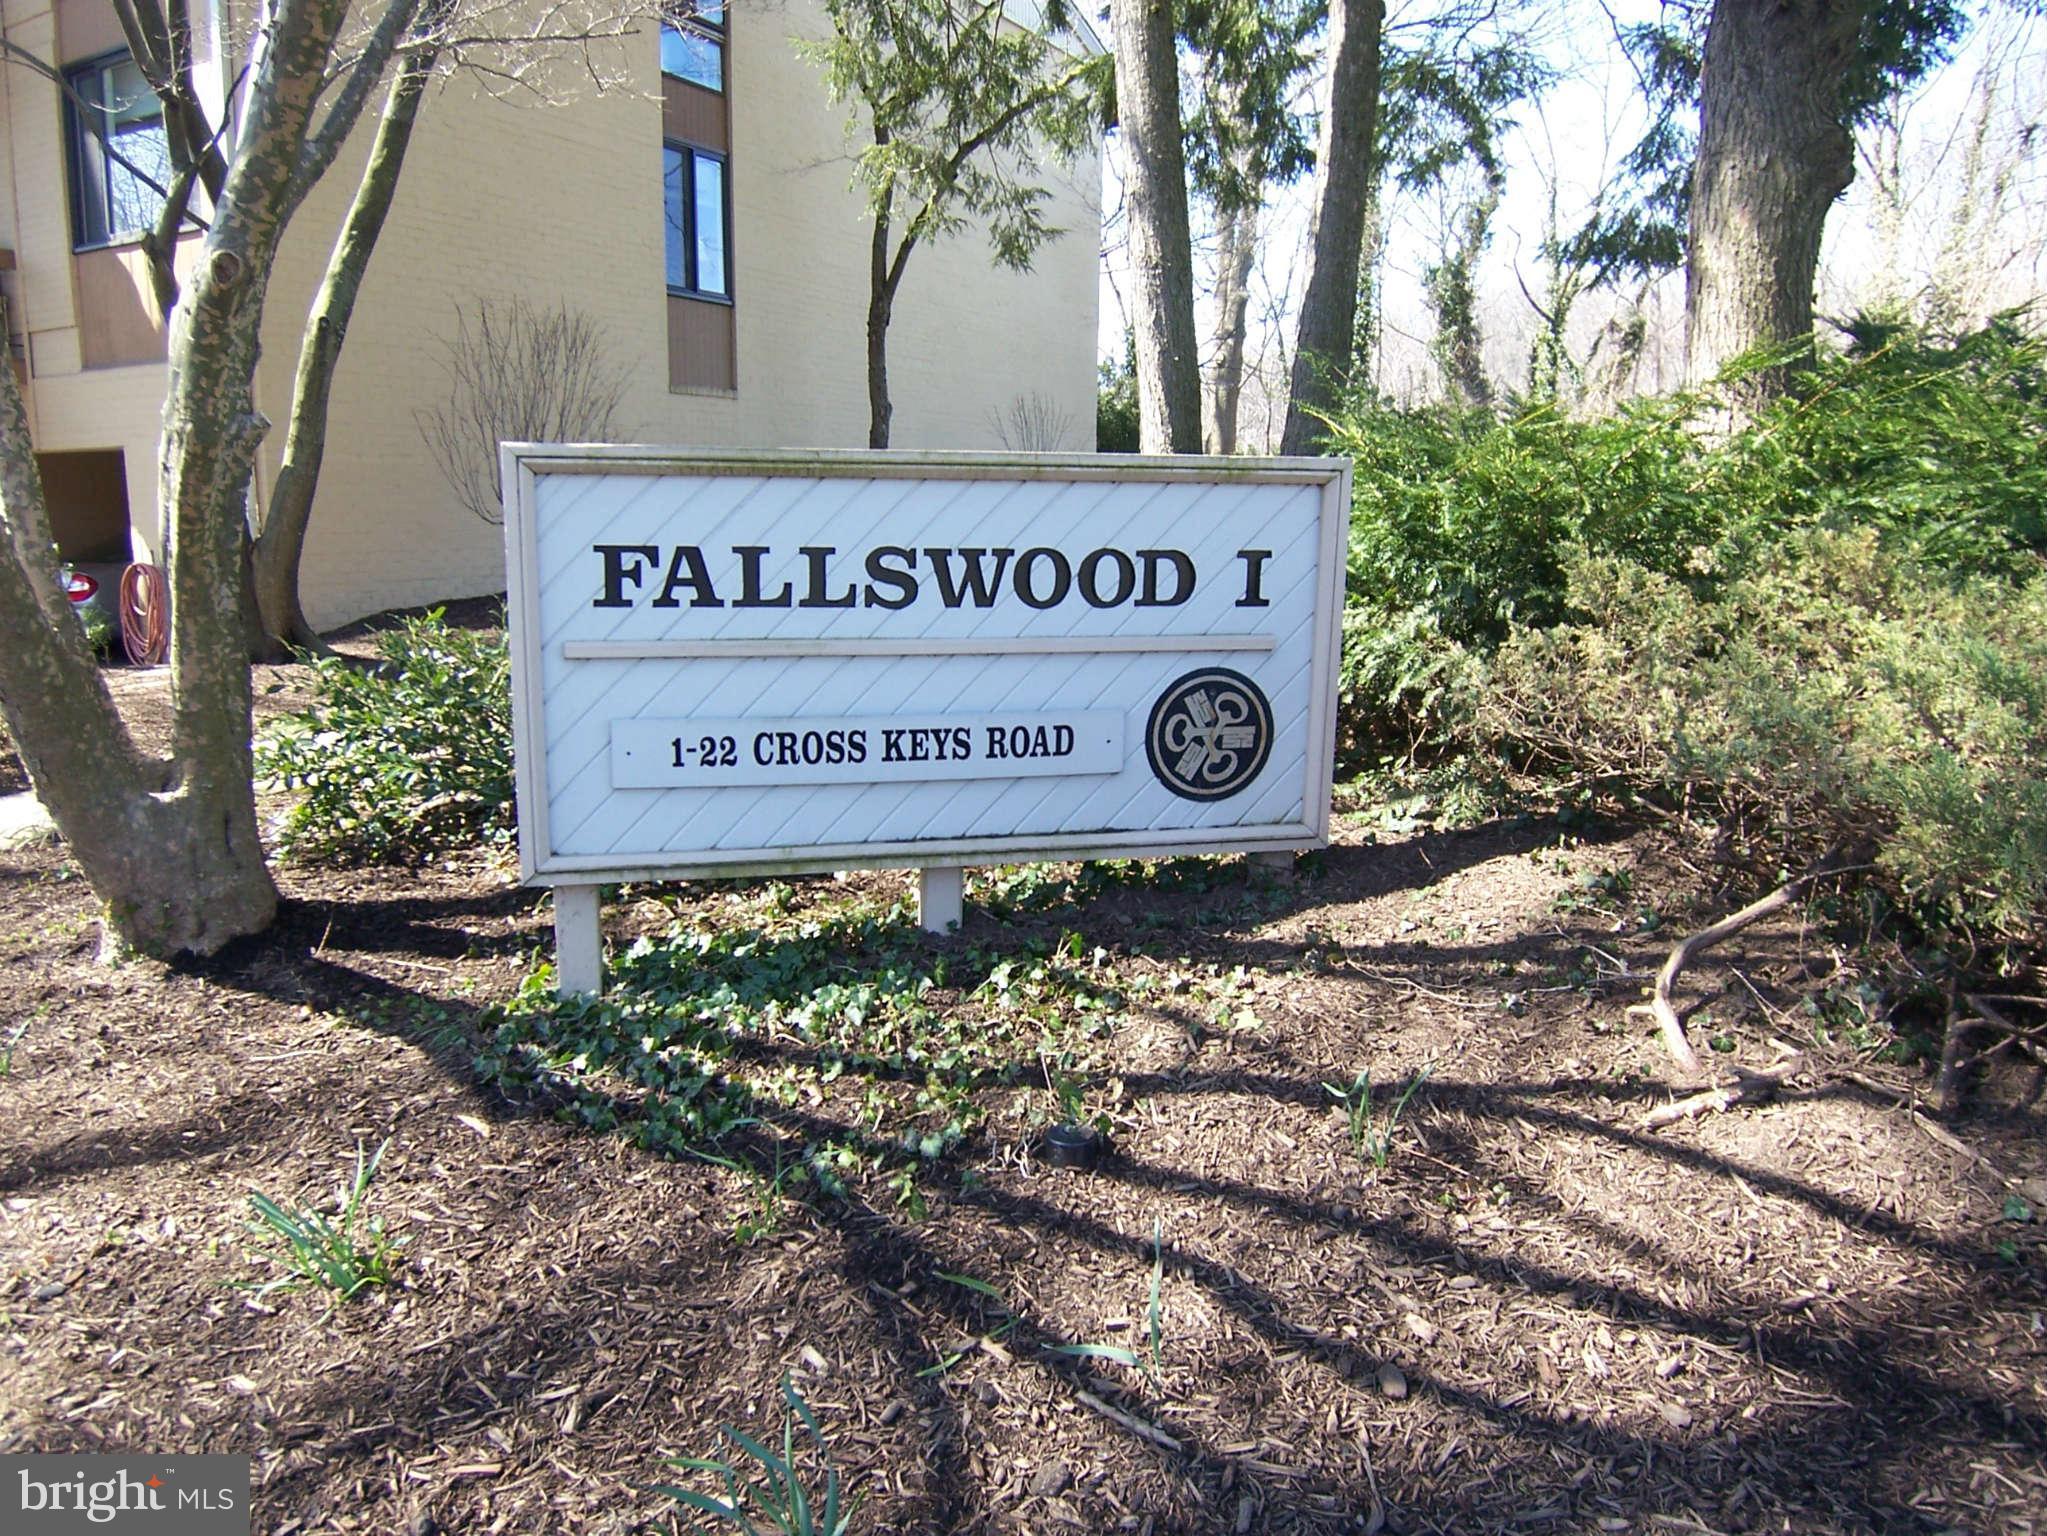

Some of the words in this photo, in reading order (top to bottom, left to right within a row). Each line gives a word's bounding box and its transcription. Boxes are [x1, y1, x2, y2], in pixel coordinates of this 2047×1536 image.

[592, 545, 1197, 610] FALLSWOOD
[1234, 549, 1273, 608] I
[671, 735, 738, 768] 1-22
[753, 729, 867, 766] CROSS
[881, 726, 972, 763] KEYS
[985, 724, 1075, 760] ROAD
